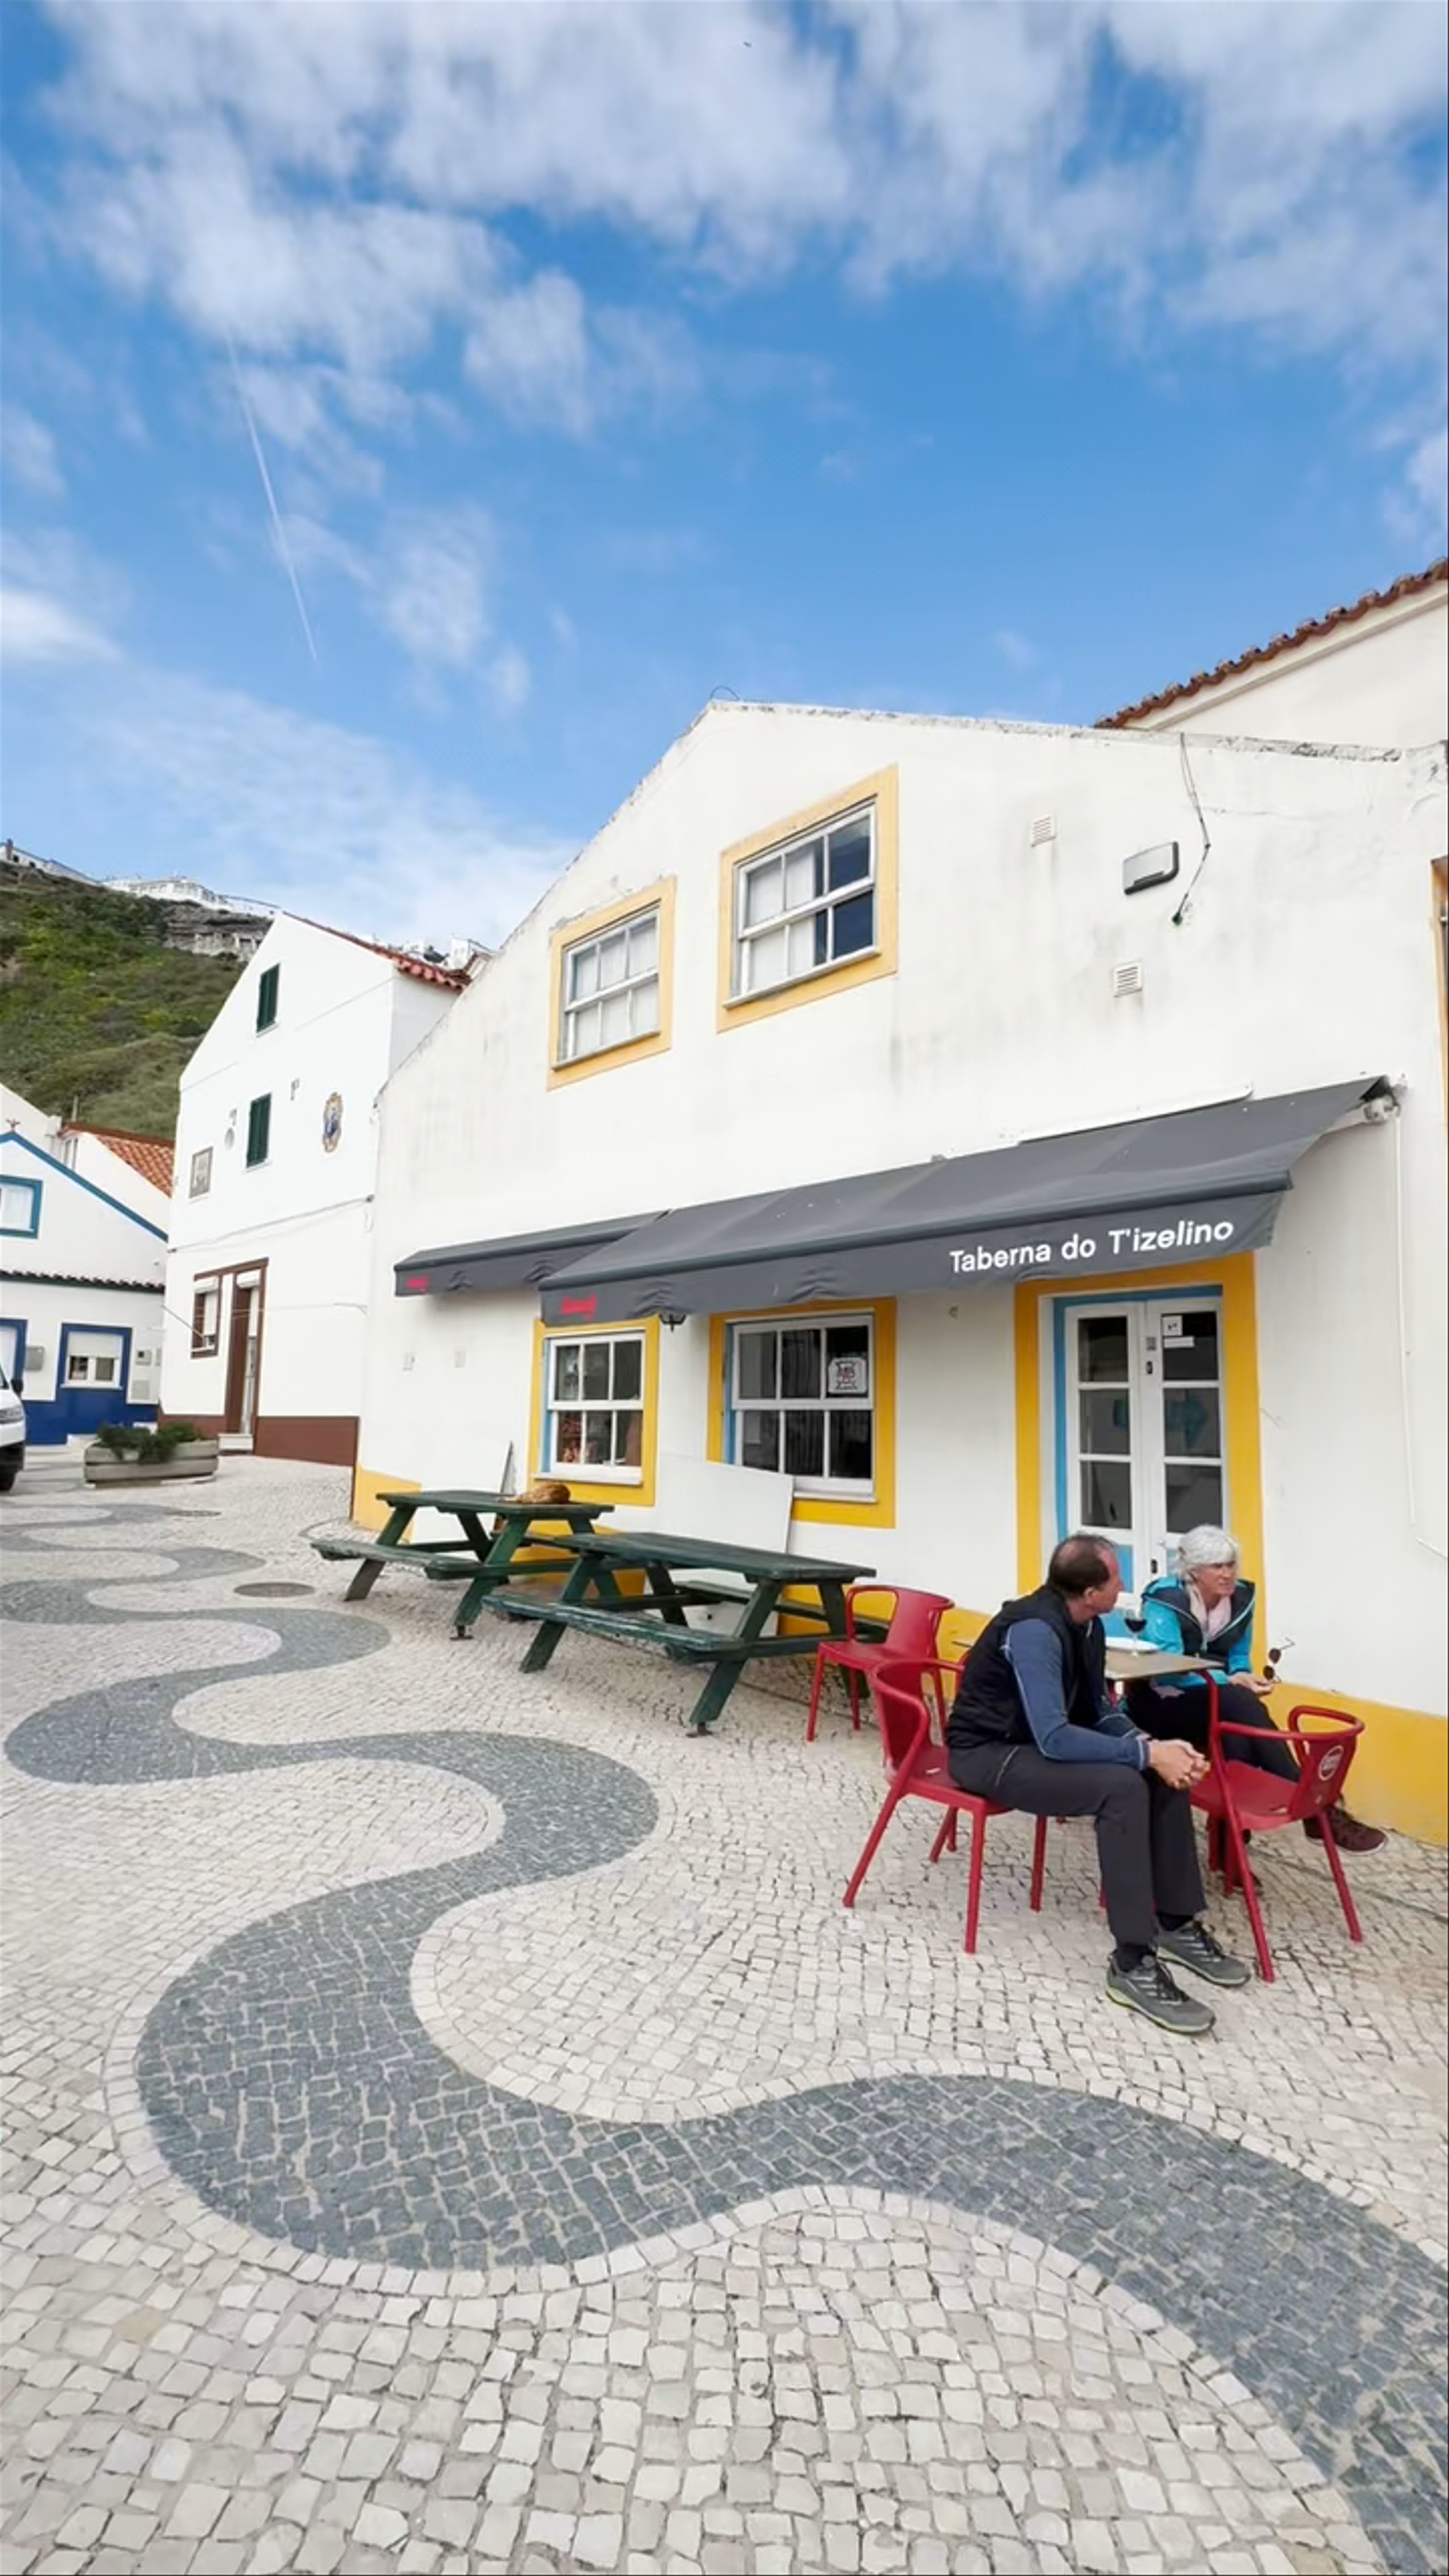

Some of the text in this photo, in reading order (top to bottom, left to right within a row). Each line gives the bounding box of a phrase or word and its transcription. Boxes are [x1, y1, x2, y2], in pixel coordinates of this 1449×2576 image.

[949, 1220, 1234, 1273] Taberna do T'izelino
